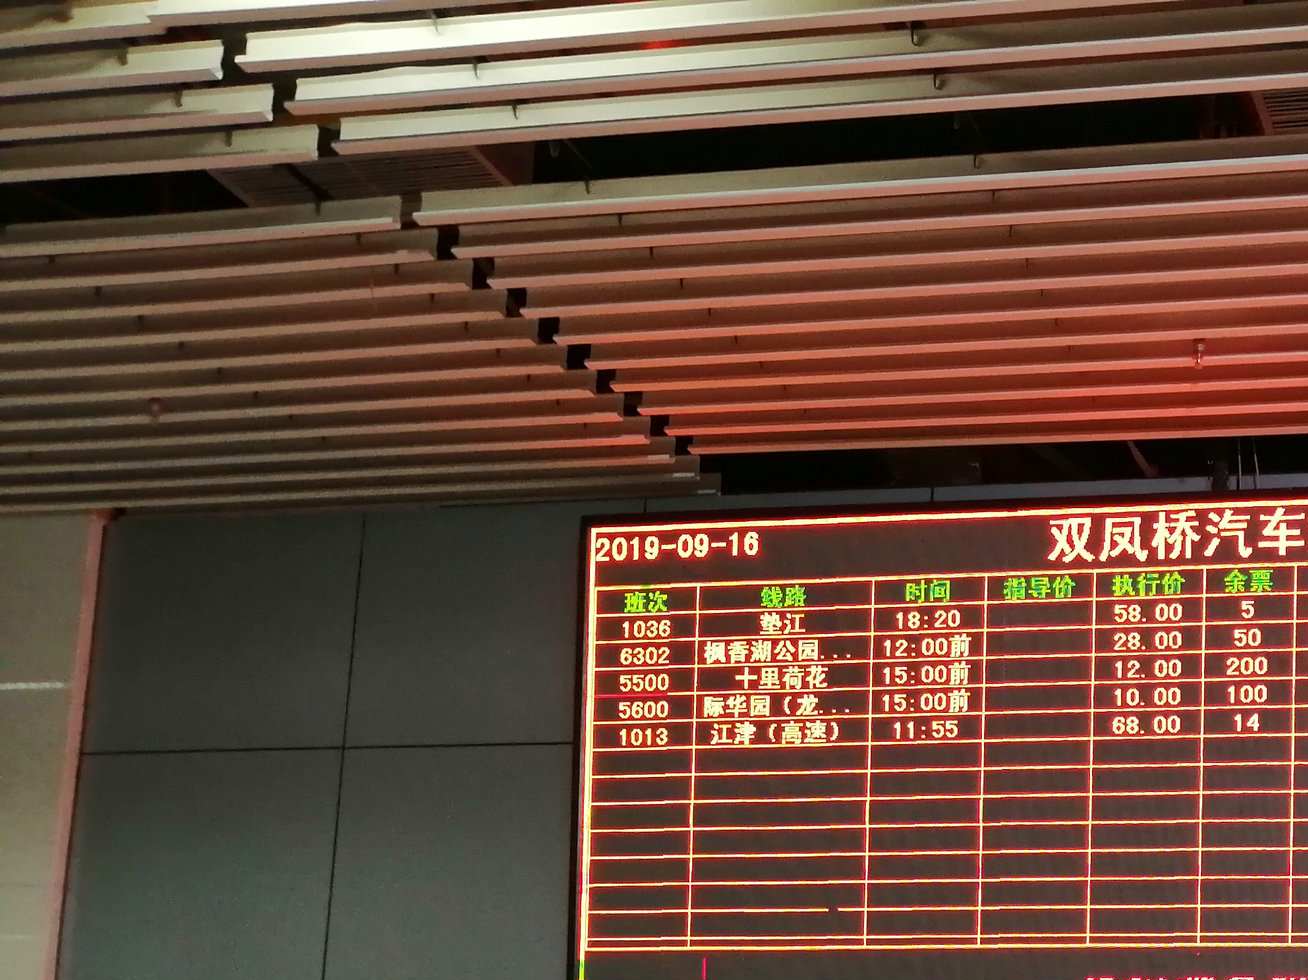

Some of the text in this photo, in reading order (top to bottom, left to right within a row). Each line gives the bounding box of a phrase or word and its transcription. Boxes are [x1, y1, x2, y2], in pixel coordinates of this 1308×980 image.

[596, 532, 759, 561] 2019-09-16
[1004, 577, 1075, 600] 指导价
[1113, 572, 1185, 597] 执行价
[1225, 570, 1274, 593] 余票
[625, 591, 668, 613] 班次
[761, 586, 806, 608] 线路
[906, 580, 951, 604] 时间
[896, 610, 961, 629] 18:20
[1114, 603, 1183, 623] 58.00
[1242, 601, 1254, 619] 5
[622, 620, 671, 638] 1036
[760, 612, 805, 634] 垫江
[884, 634, 971, 658] 12:00前
[1114, 631, 1182, 651] 28.00
[1234, 629, 1261, 647] 50
[620, 647, 670, 665] 6302
[1227, 656, 1268, 676] 200
[736, 665, 828, 690] 十里荷花
[883, 662, 971, 686] 15:00前
[1114, 660, 1181, 679] 12.00
[620, 674, 669, 692] 5500
[883, 689, 970, 713] 15:00前
[1114, 688, 1180, 707] 10.00
[1227, 685, 1267, 704] 100
[619, 701, 669, 719] 5600
[894, 721, 958, 740] 11:55
[1112, 716, 1180, 735] 68.00
[1234, 713, 1259, 732] 14
[619, 728, 668, 746] 1013
